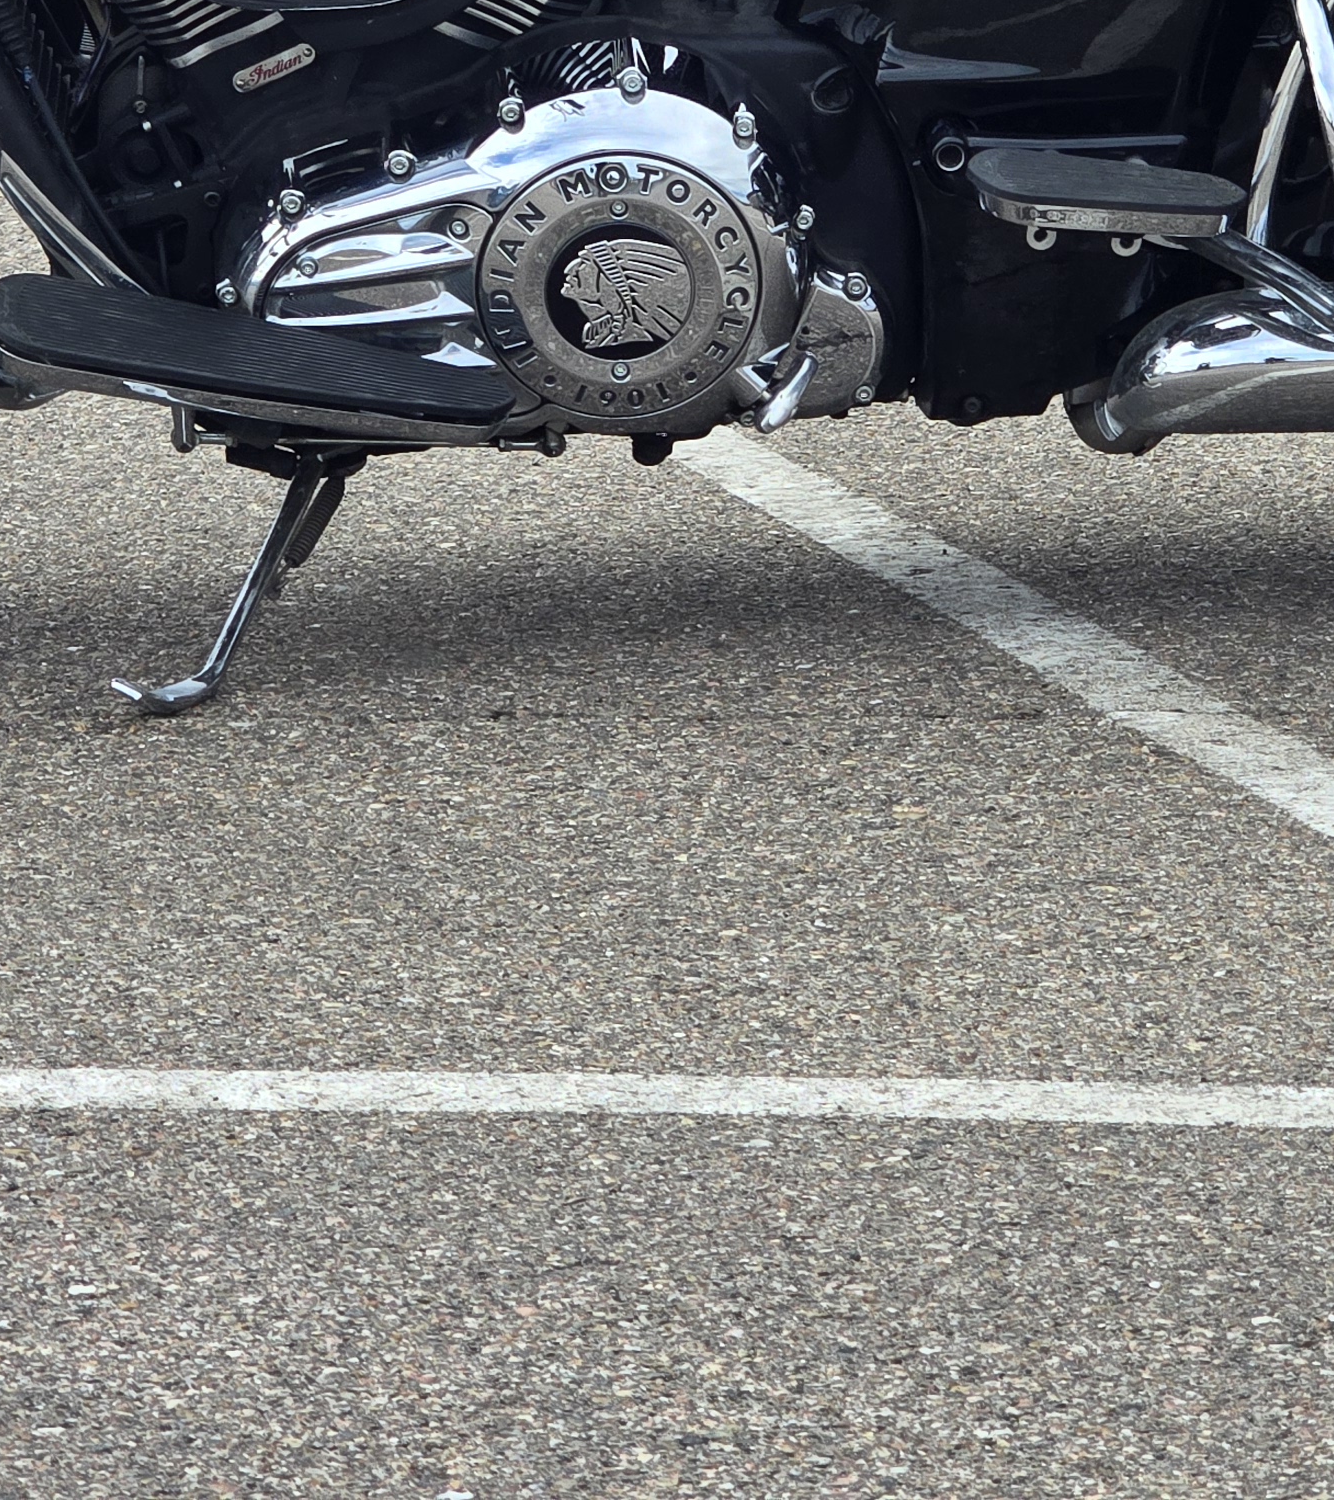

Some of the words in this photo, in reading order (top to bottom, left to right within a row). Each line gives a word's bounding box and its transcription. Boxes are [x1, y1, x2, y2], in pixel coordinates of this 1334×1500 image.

[247, 54, 303, 87] Indian
[487, 200, 548, 369] INDIAN
[556, 161, 751, 364] MOTORCYCLE
[576, 381, 671, 409] 1901
